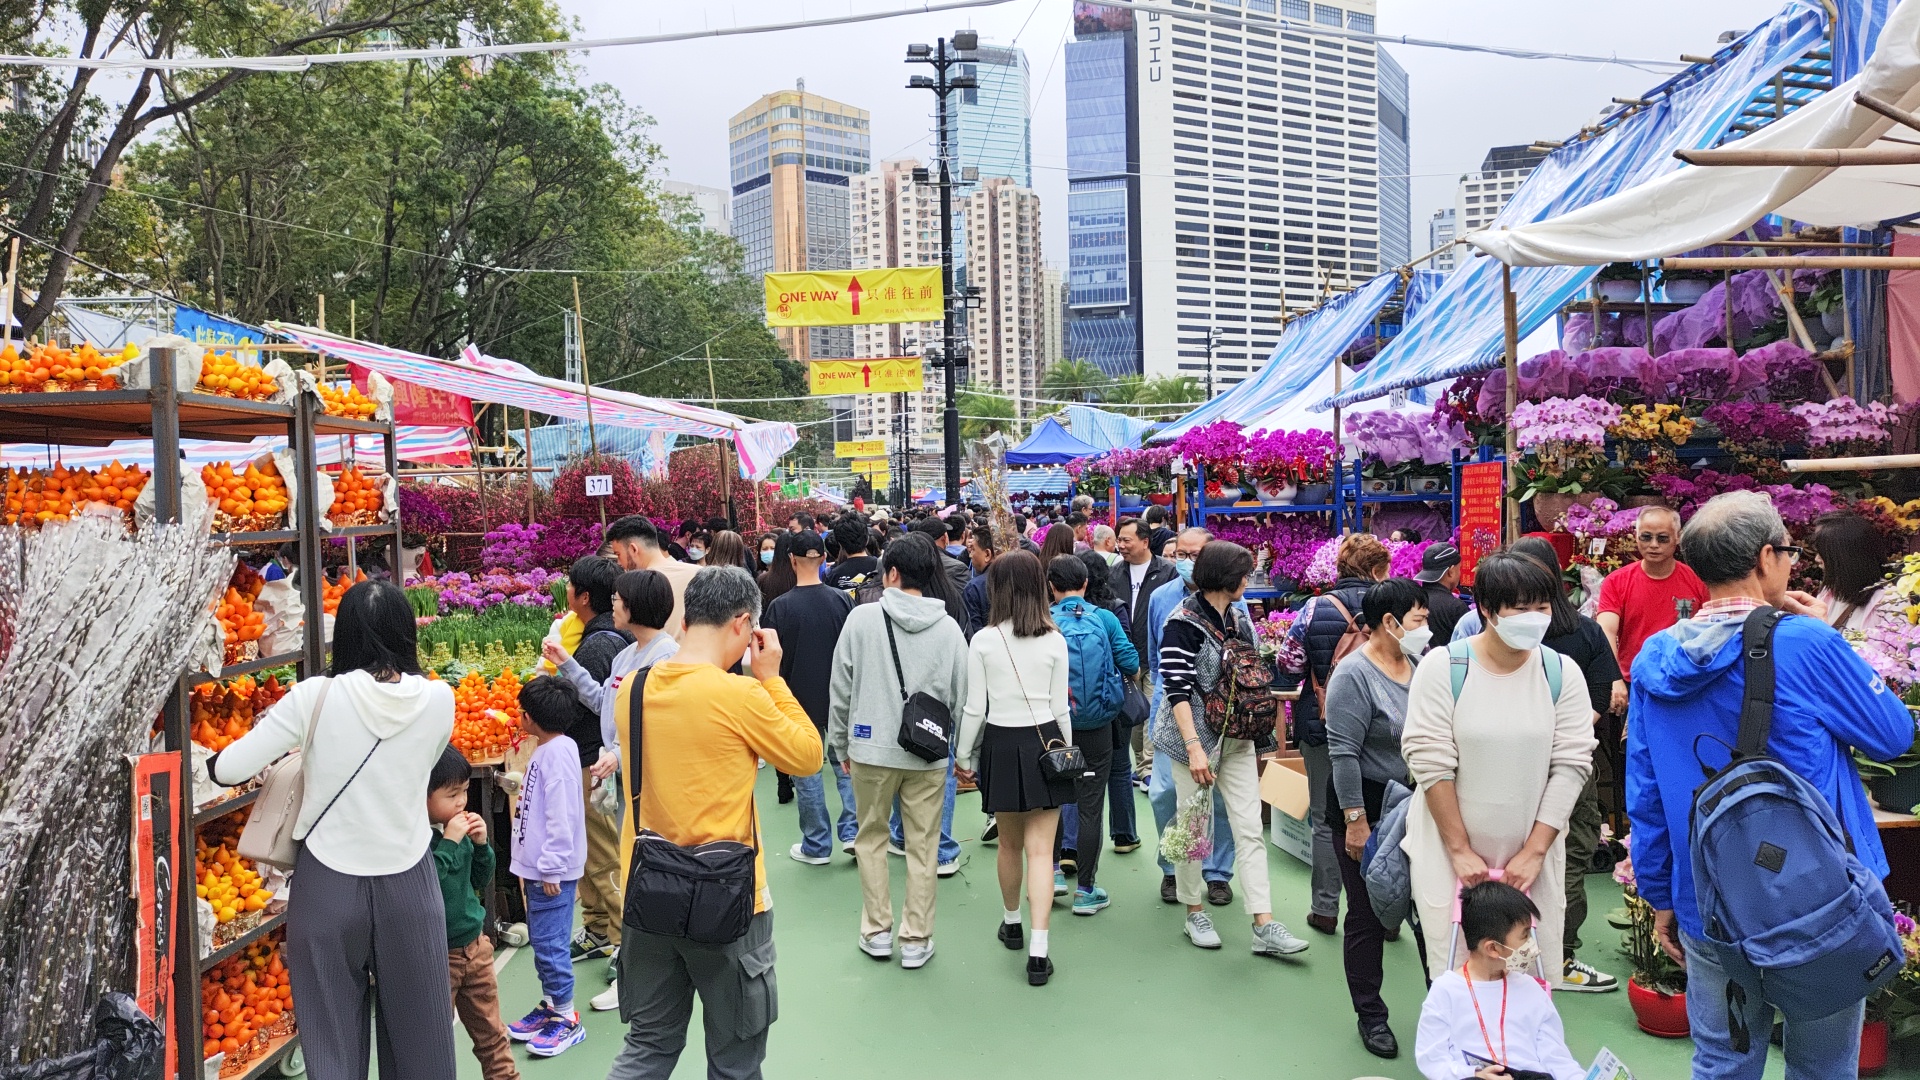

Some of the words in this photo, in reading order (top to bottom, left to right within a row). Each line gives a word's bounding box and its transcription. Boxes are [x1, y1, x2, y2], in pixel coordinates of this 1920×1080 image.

[779, 291, 807, 304] ONE
[810, 290, 839, 302] WAY
[867, 285, 933, 301] 只准往前
[818, 371, 836, 379] ONE
[838, 371, 856, 379] WAY
[1390, 390, 1403, 408] 305
[589, 478, 609, 493] 371
[519, 761, 538, 847] MINECRAFT
